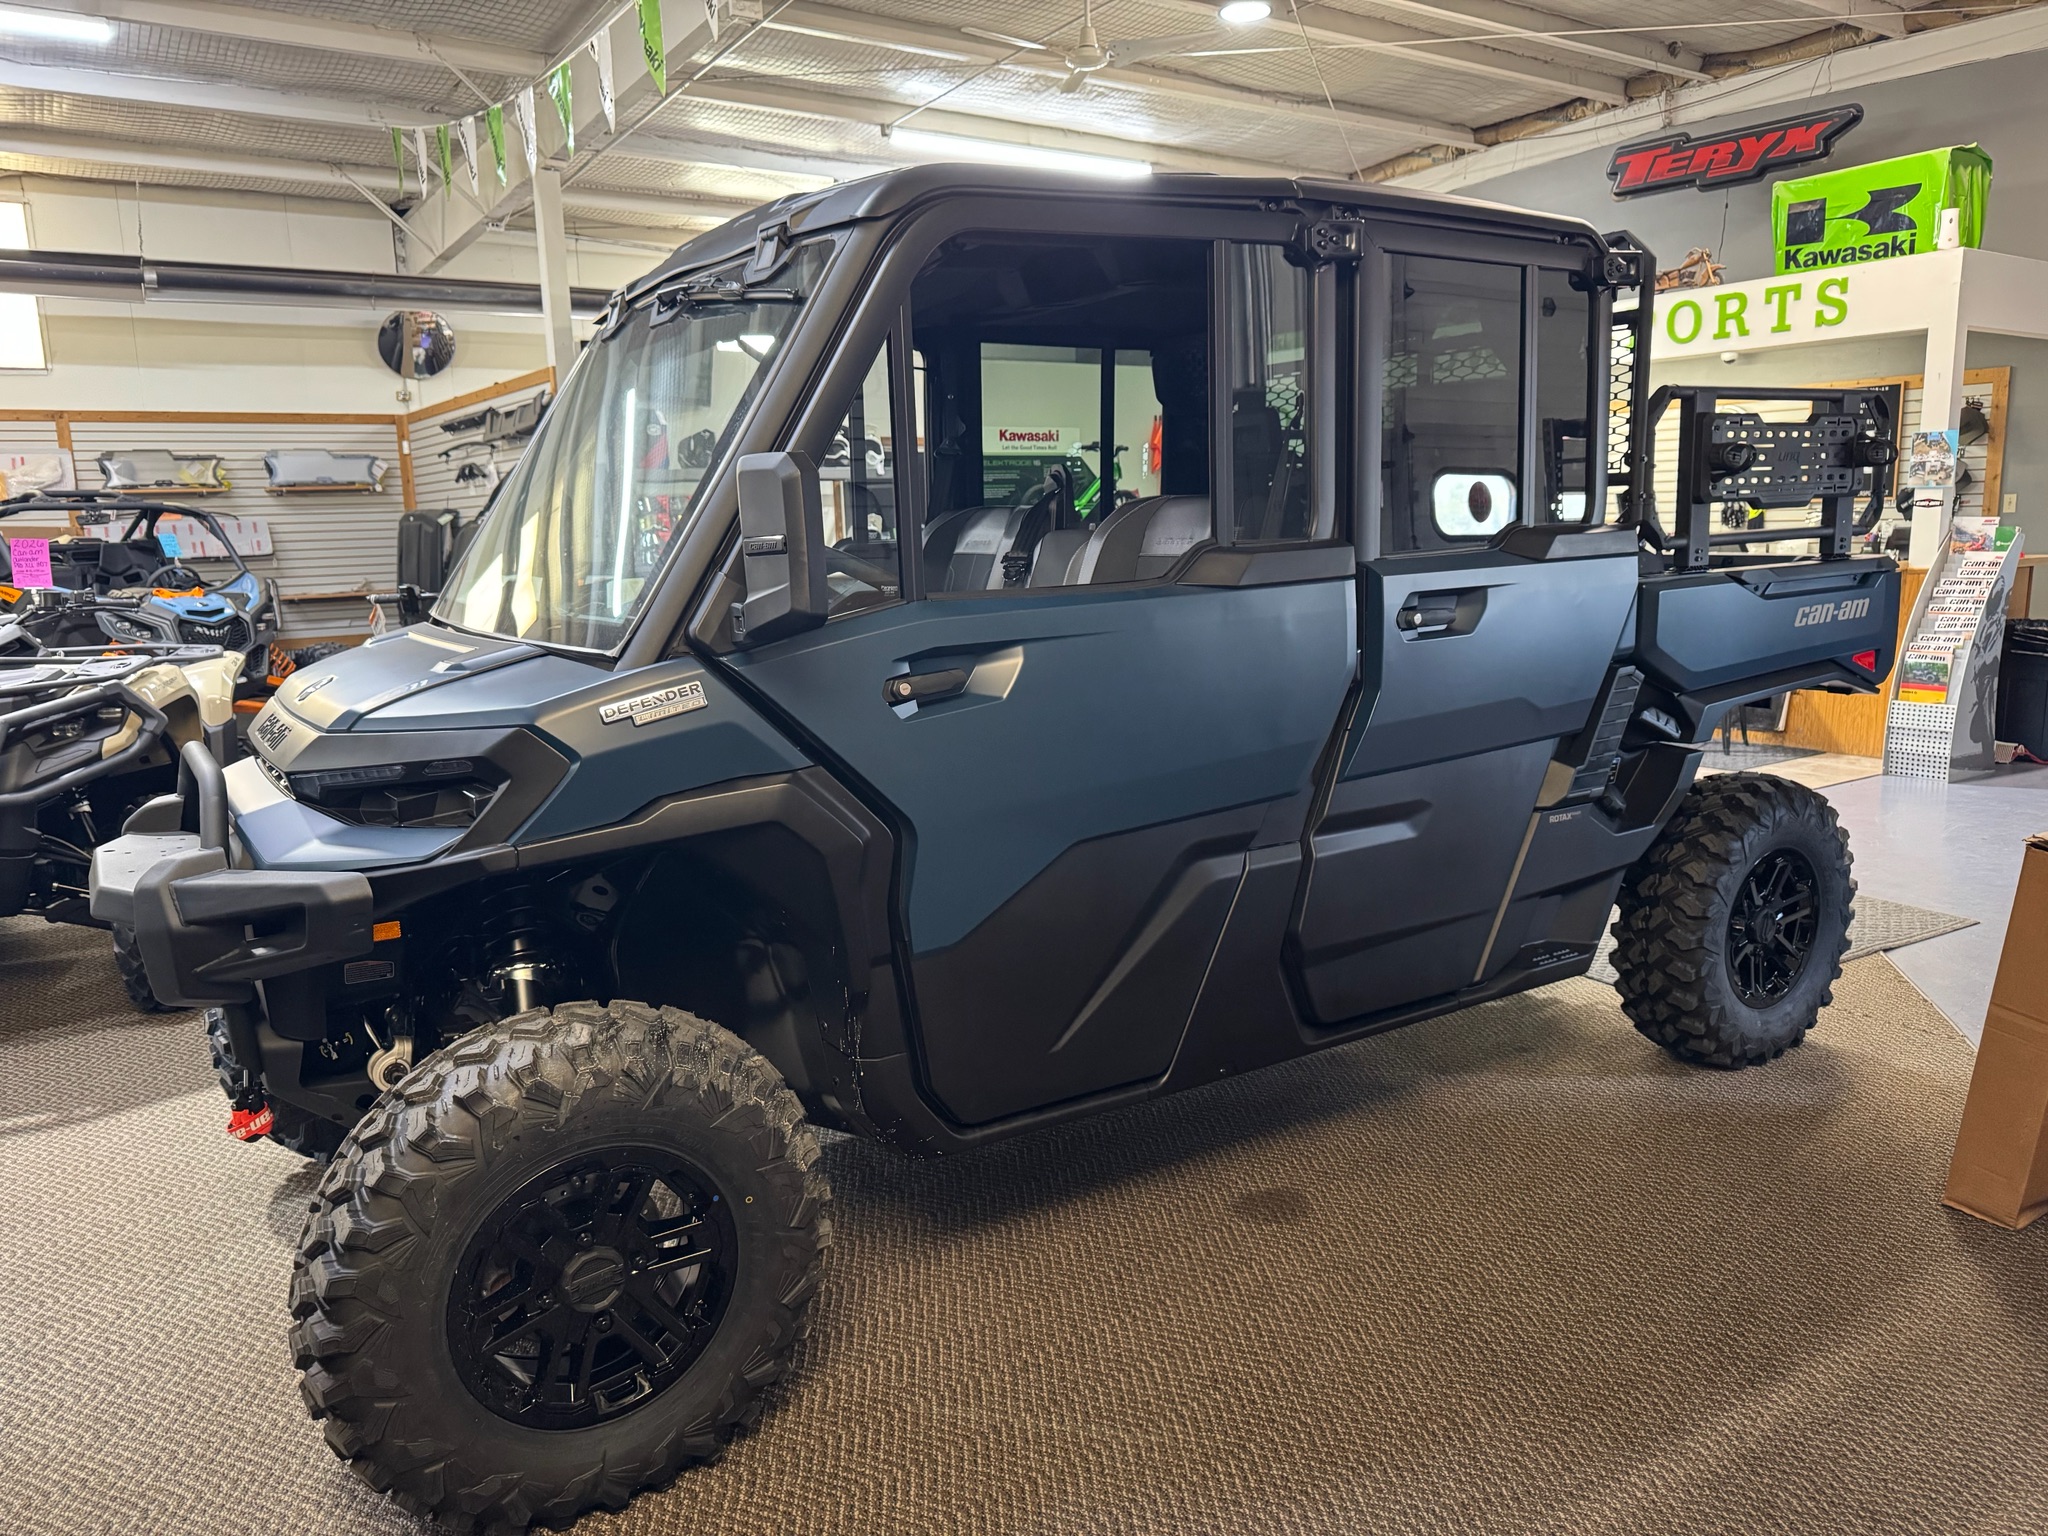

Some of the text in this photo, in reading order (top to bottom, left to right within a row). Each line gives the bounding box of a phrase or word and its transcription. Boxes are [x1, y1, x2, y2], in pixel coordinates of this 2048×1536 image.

[1615, 120, 1833, 188] TERYX
[1784, 231, 1918, 271] Kawasaki
[1653, 276, 1849, 345] ORTS
[999, 429, 1060, 442] Kawasaki
[14, 540, 45, 549] 2026
[1935, 588, 1976, 596] can-am
[1794, 597, 1871, 628] can-am
[1930, 605, 1973, 613] can-am
[1920, 635, 1962, 643] can-am
[1910, 644, 1952, 652] can-am
[603, 683, 702, 719] DEFENDER
[1549, 812, 1573, 824] ROTAX
